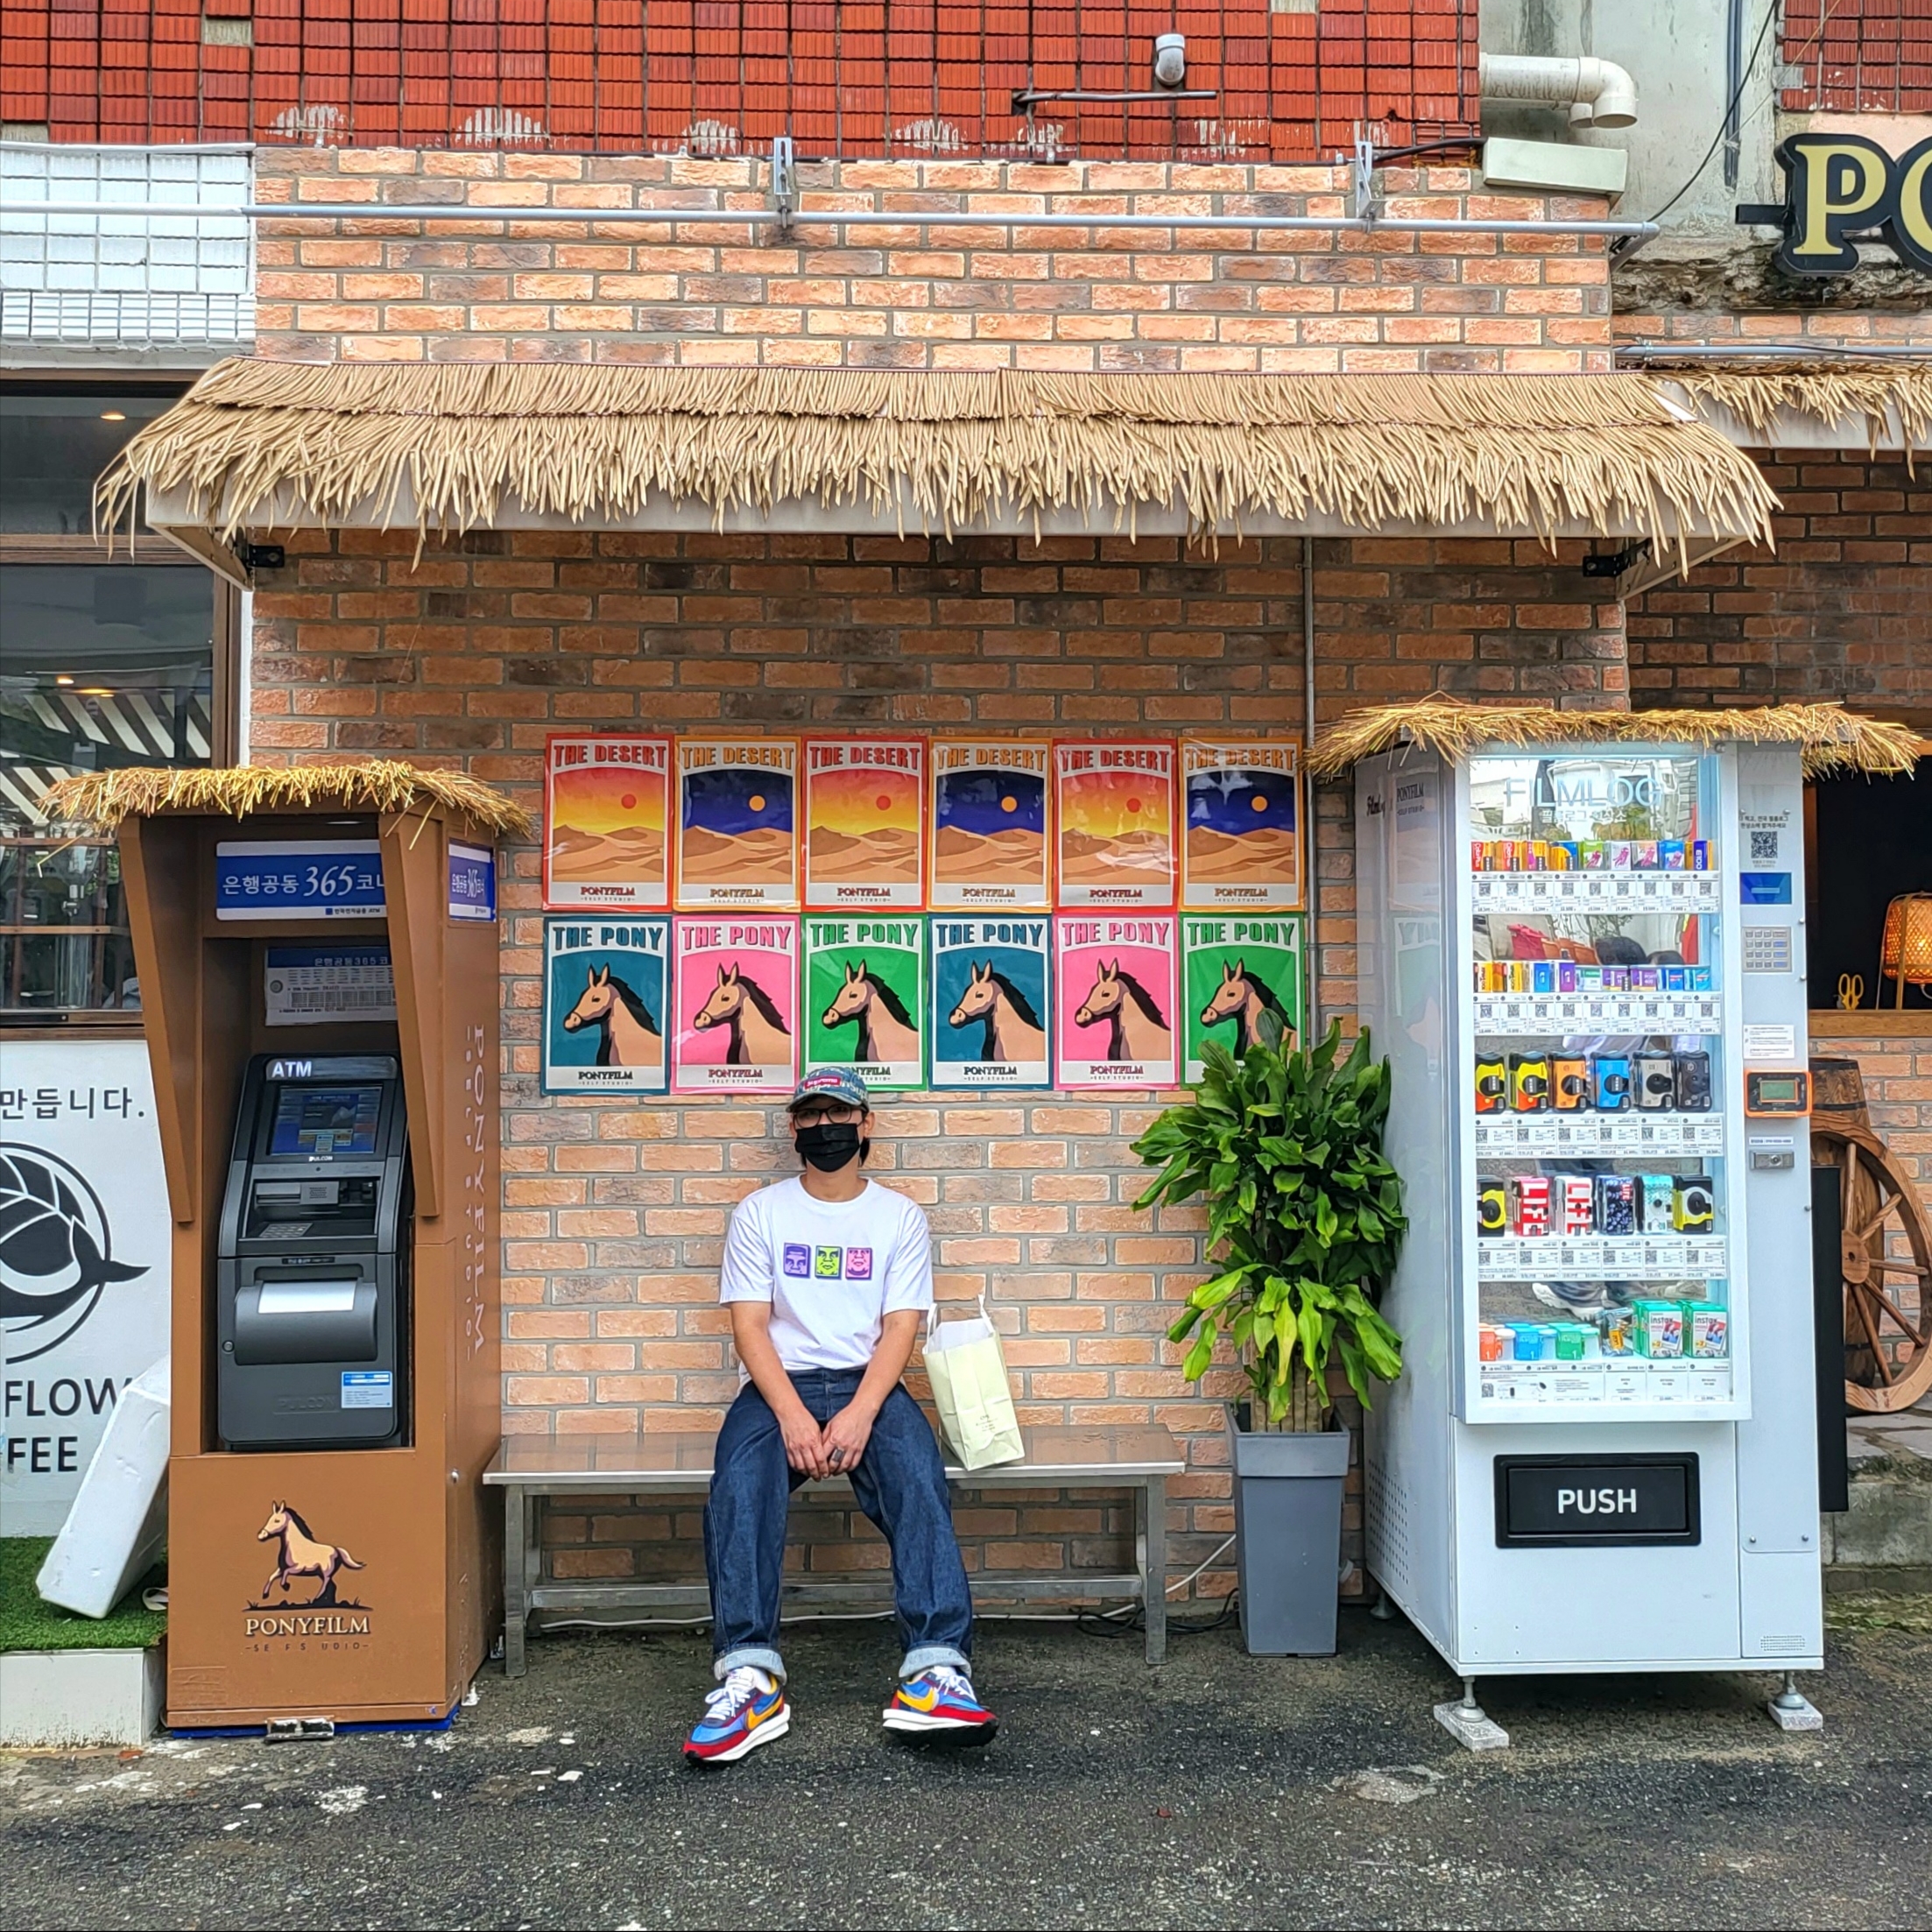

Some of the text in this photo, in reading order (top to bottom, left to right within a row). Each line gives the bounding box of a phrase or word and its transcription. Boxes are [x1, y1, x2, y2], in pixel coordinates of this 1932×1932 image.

[554, 744, 666, 768] THE DESERT
[682, 746, 794, 769] THE DESERT
[809, 745, 920, 769] THE DESERT
[936, 748, 1046, 770] THE DESERT
[1061, 750, 1169, 772] THE DESERT
[1186, 748, 1295, 770] THE DESERT
[1505, 777, 1664, 807] FILMLOG
[222, 875, 300, 895] 은행공동
[303, 865, 357, 897] 365
[581, 886, 636, 897] PONYFILM
[836, 887, 892, 897] PONYFILM
[709, 889, 765, 899] PONYFILM
[962, 888, 1016, 898] PONYFILM
[1089, 889, 1143, 899] PONYFILM
[1215, 888, 1268, 898] PONYFILM
[553, 927, 663, 950] THE PONY
[682, 926, 792, 949] THE PONY
[810, 923, 919, 947] THE PONY
[936, 923, 1044, 947] THE PONY
[1062, 923, 1169, 946] THE PONY
[1188, 922, 1294, 946] THE PONY
[271, 1061, 312, 1078] ATM
[578, 1070, 633, 1081] PONYFILM
[709, 1068, 763, 1079] PONYFILM
[854, 1067, 892, 1076] NYFILM
[963, 1066, 1017, 1076] PONYFILM
[1090, 1065, 1144, 1075] PONYFILM
[0, 1087, 145, 1120] 만듭니다.
[475, 1024, 484, 1354] PONYFILM
[1523, 1182, 1548, 1236] LIFE
[1567, 1183, 1591, 1235] LIFE
[0, 1436, 78, 1472] FEE
[1557, 1488, 1637, 1514] PUSH
[244, 1616, 370, 1637] PONYFILM
